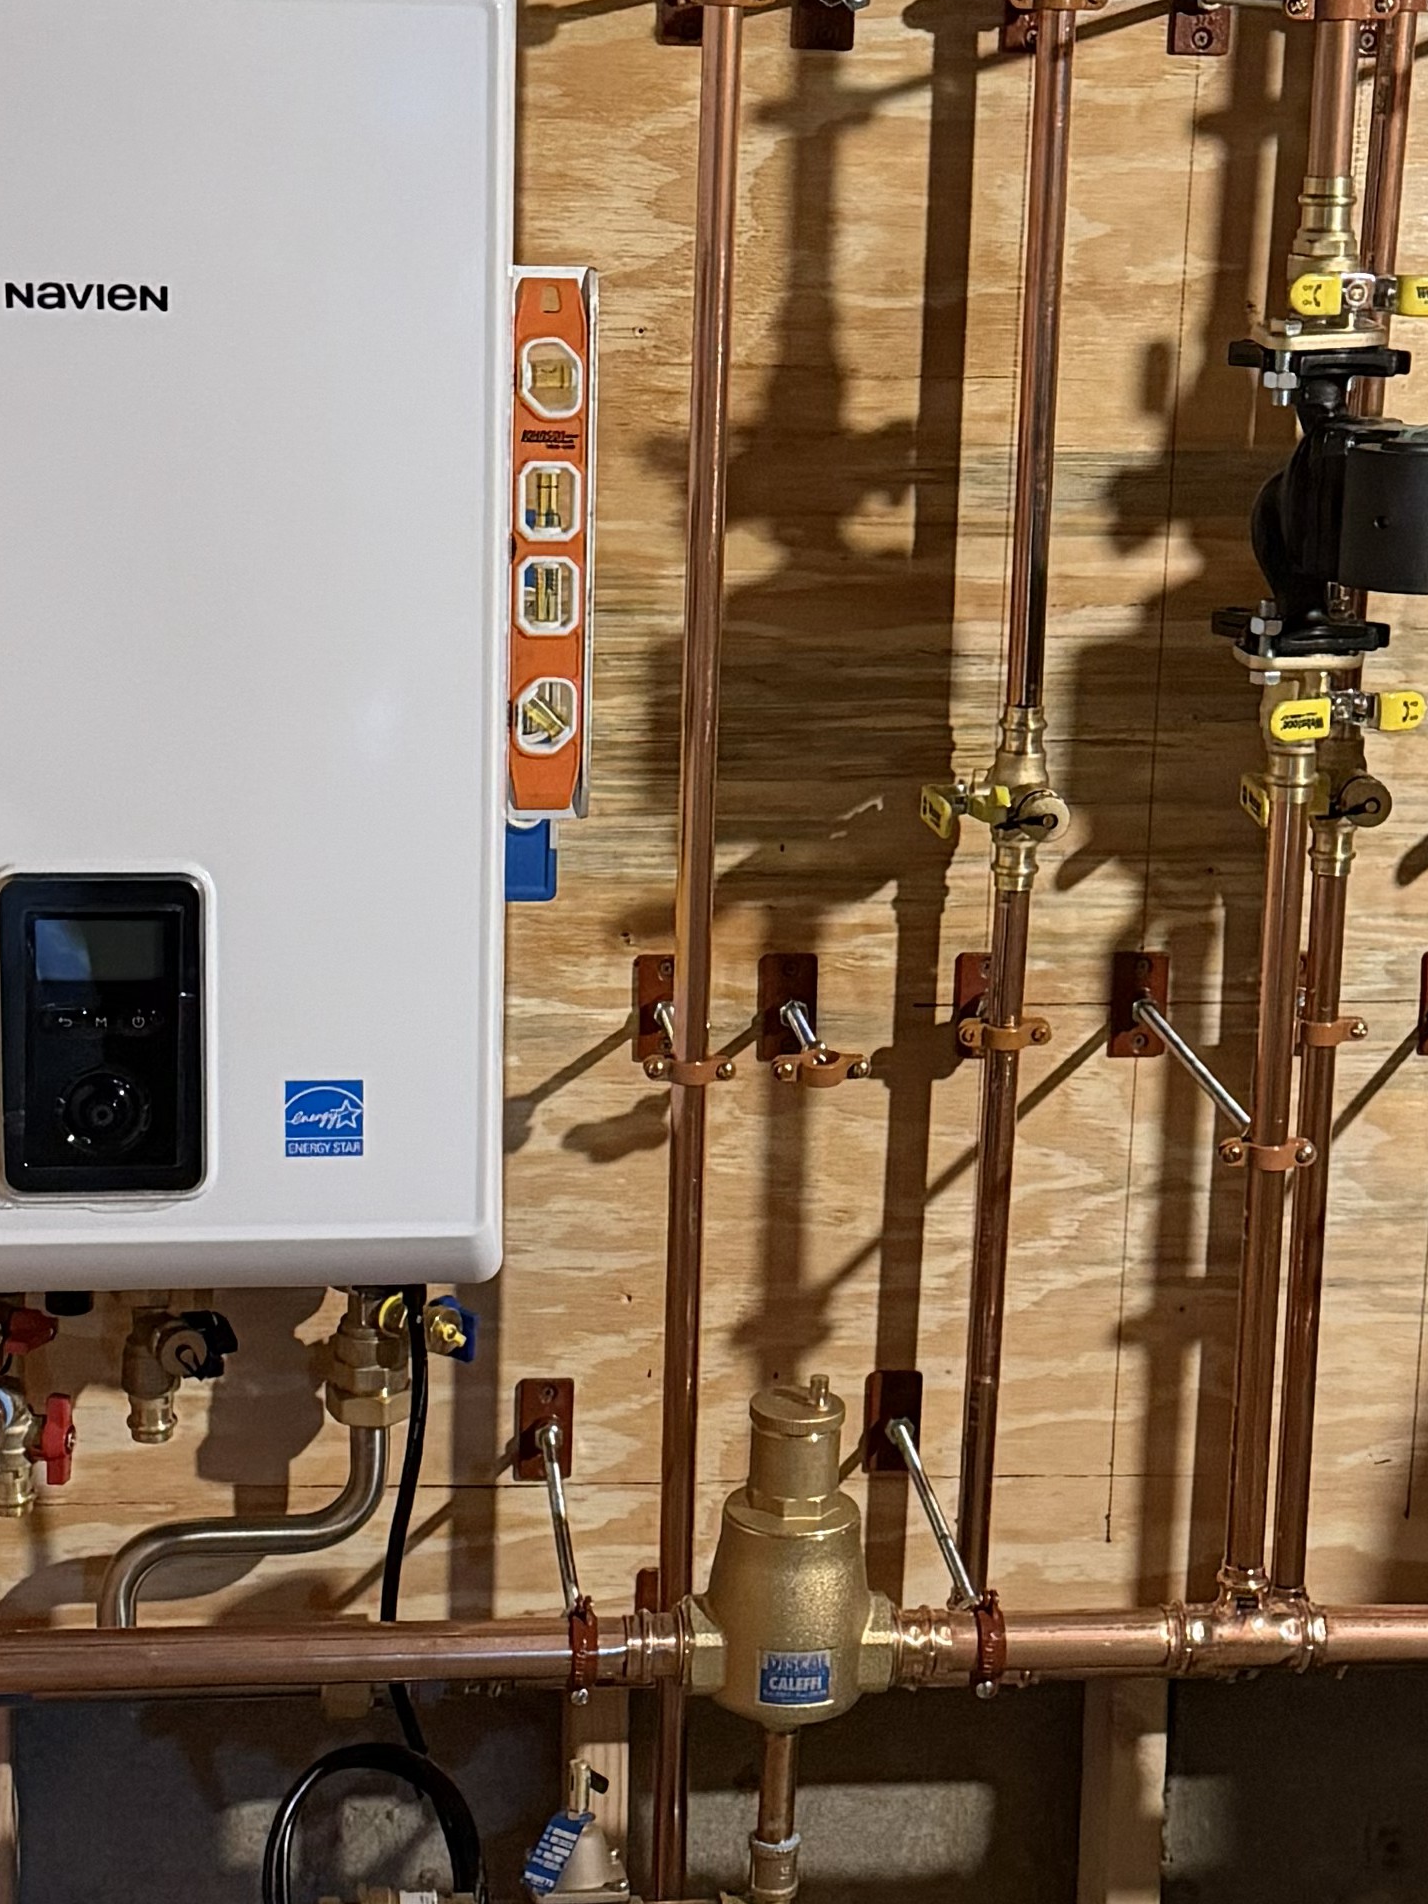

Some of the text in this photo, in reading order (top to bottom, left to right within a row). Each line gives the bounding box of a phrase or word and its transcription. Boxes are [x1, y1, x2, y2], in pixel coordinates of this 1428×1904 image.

[288, 1141, 361, 1155] ENERGY STAR
[769, 1676, 822, 1692] CALEFFI
